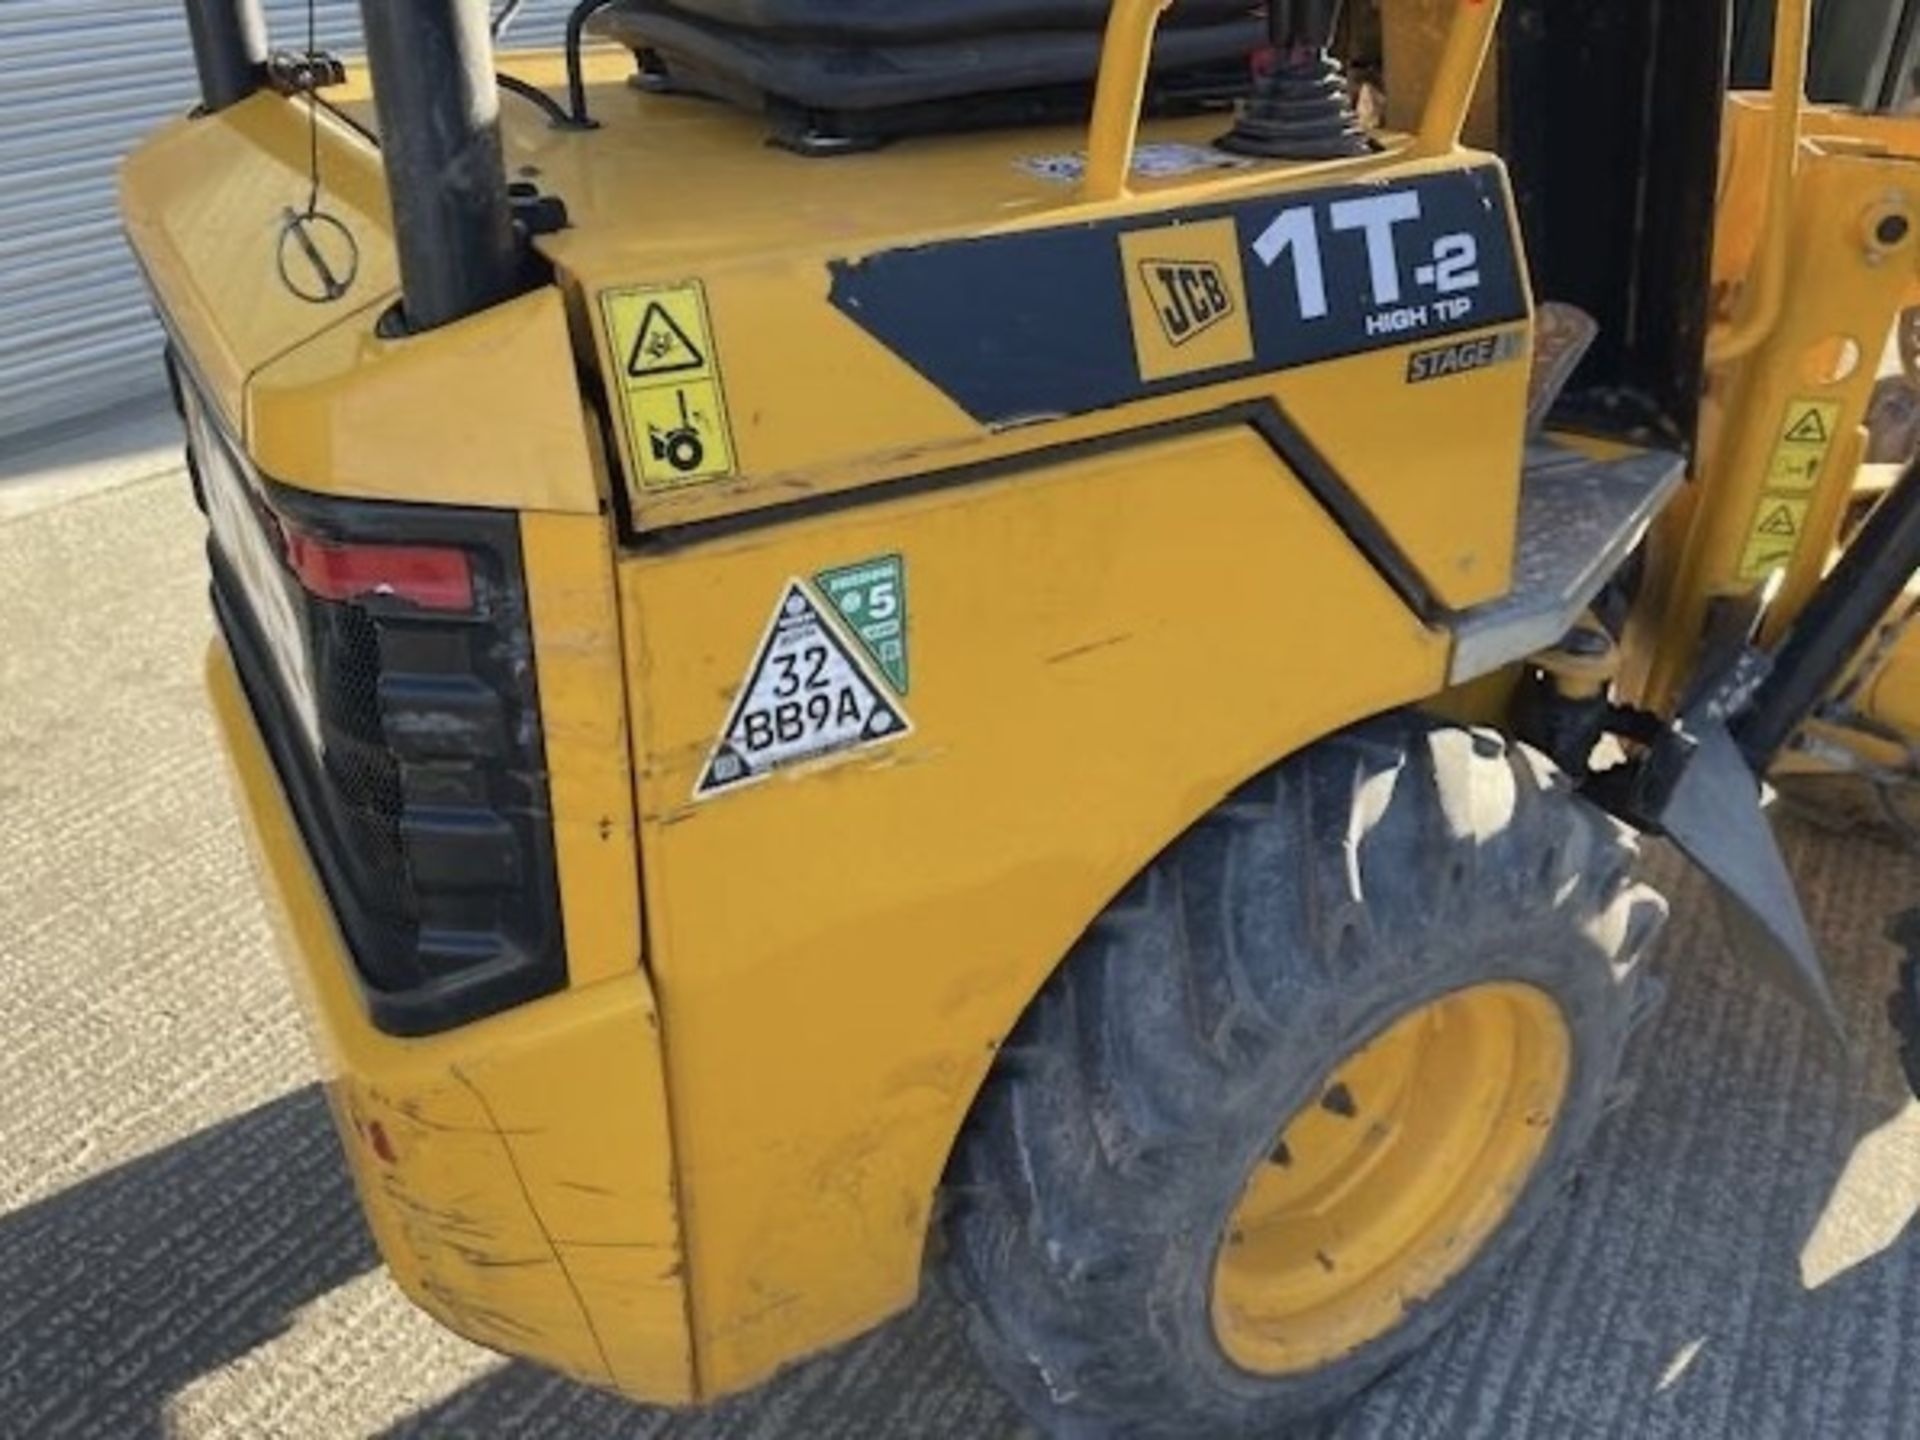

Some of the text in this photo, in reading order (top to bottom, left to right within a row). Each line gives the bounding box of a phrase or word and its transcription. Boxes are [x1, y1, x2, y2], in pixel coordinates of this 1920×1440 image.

[1156, 267, 1228, 335] JCB
[1365, 296, 1471, 336] HIGH TIP
[1410, 338, 1494, 381] STAGE
[868, 582, 897, 619] 5
[772, 646, 832, 698] 32
[743, 685, 862, 751] BB9A
